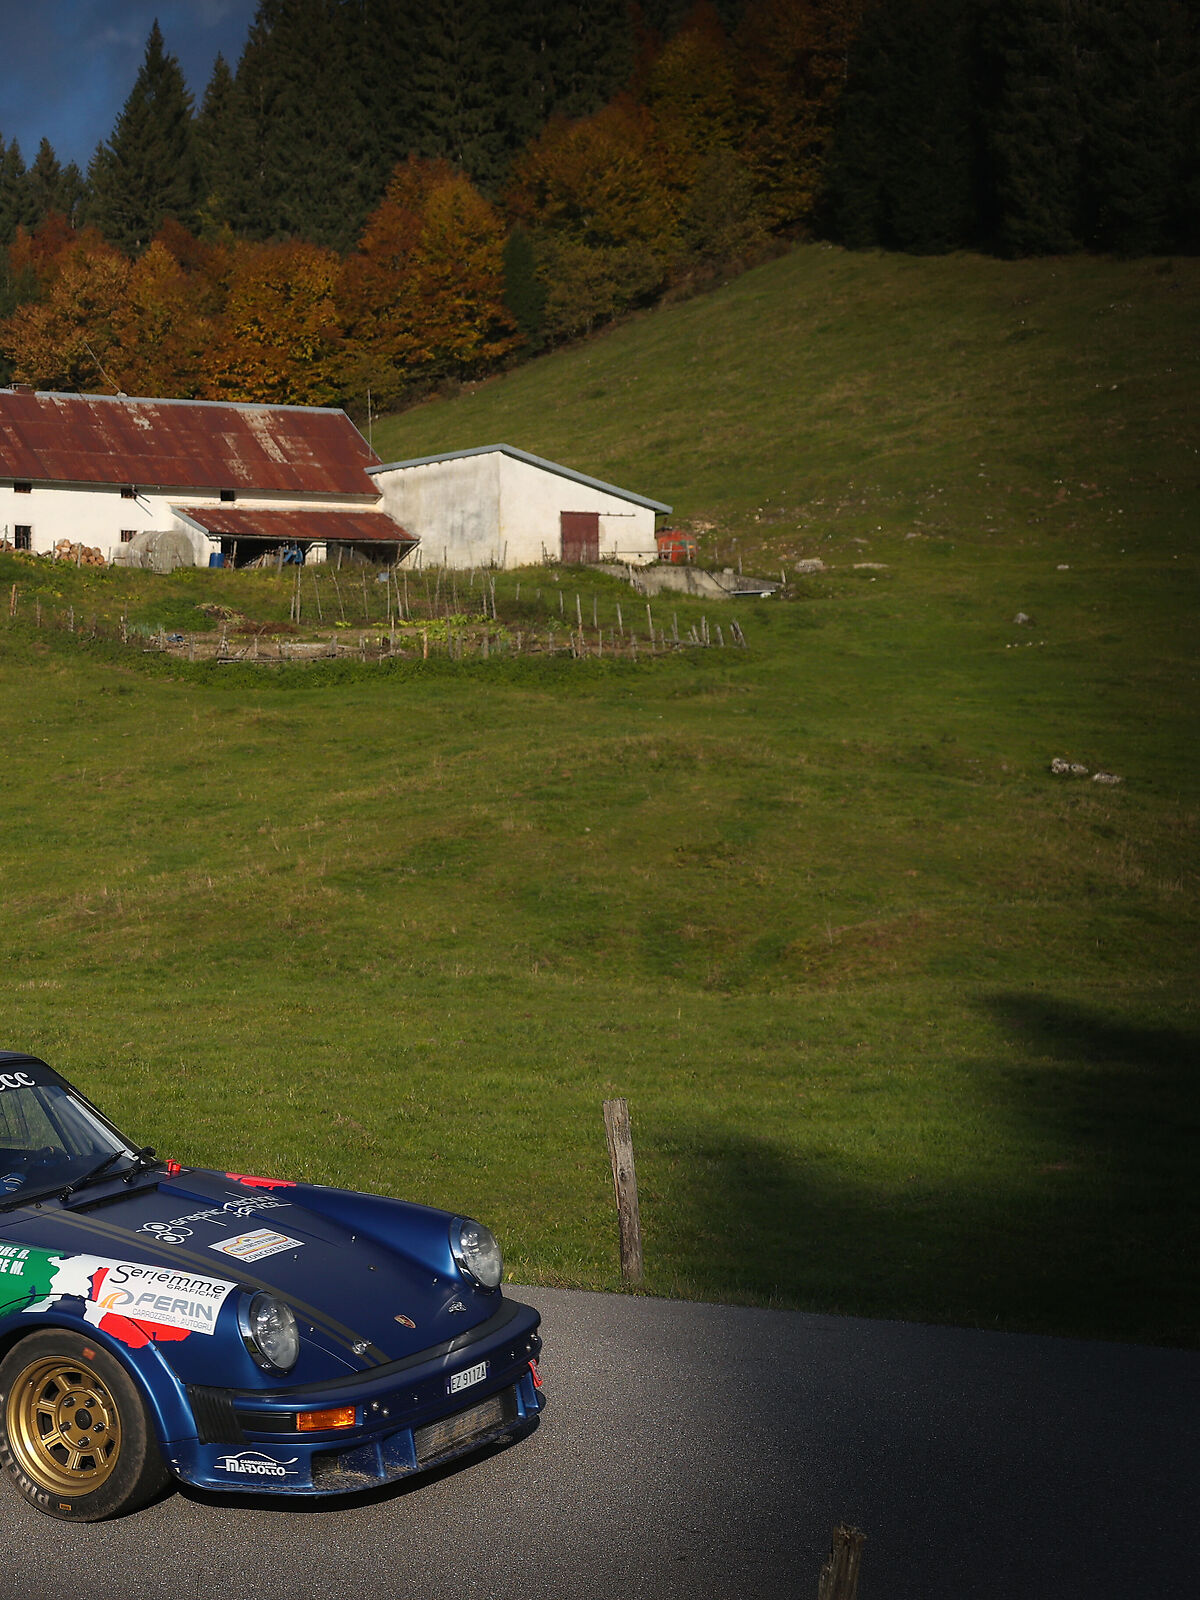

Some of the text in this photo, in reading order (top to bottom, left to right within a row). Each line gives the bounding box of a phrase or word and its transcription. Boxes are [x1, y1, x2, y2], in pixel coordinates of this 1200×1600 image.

[9, 1260, 25, 1276] M.
[109, 1264, 227, 1294] Seriemme
[166, 1284, 222, 1300] GRAFICHE
[134, 1292, 213, 1322] PERIN
[132, 1308, 176, 1324] CARROZZERIA
[181, 1317, 213, 1332] AUTOGRU
